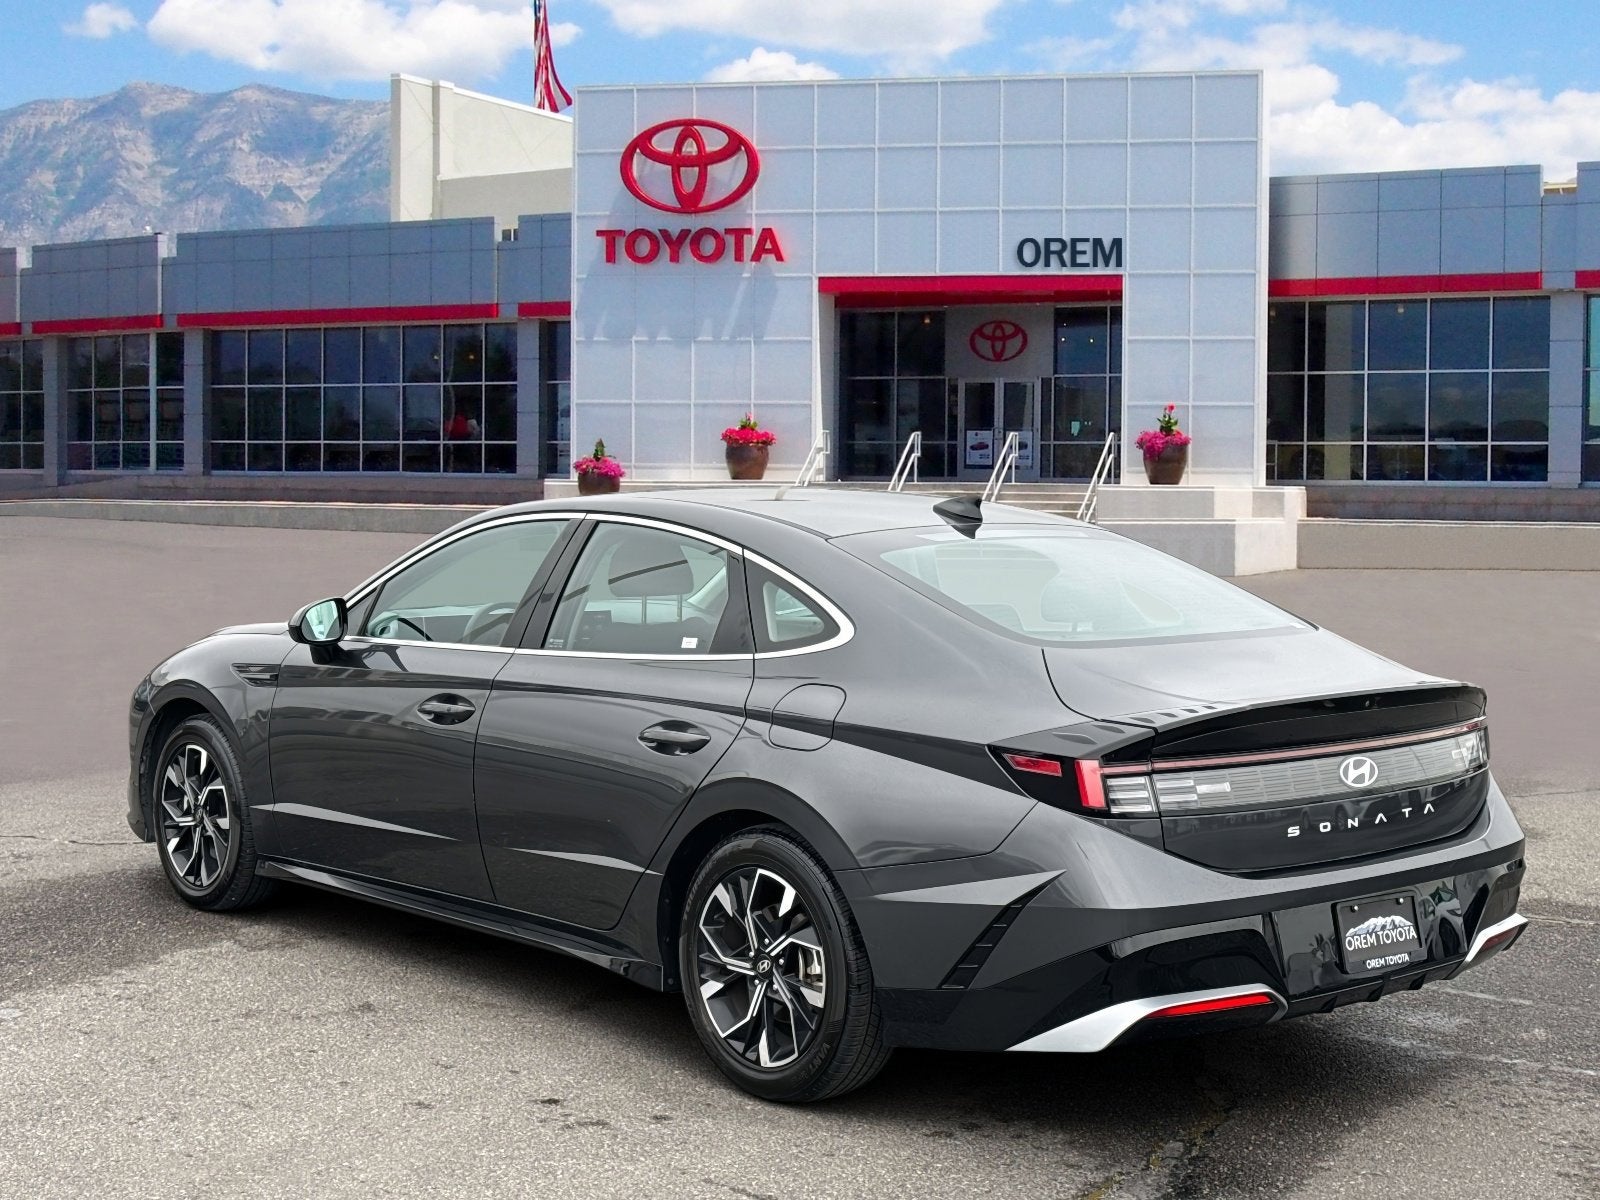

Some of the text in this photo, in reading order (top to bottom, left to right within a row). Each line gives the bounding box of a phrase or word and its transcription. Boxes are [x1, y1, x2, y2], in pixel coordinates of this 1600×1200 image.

[596, 227, 785, 264] TOYOTA
[1017, 237, 1123, 268] OREM
[1287, 803, 1435, 838] SONATA
[1345, 925, 1418, 951] OREM TOYOTA
[1366, 952, 1410, 969] OREM TOYOTA
